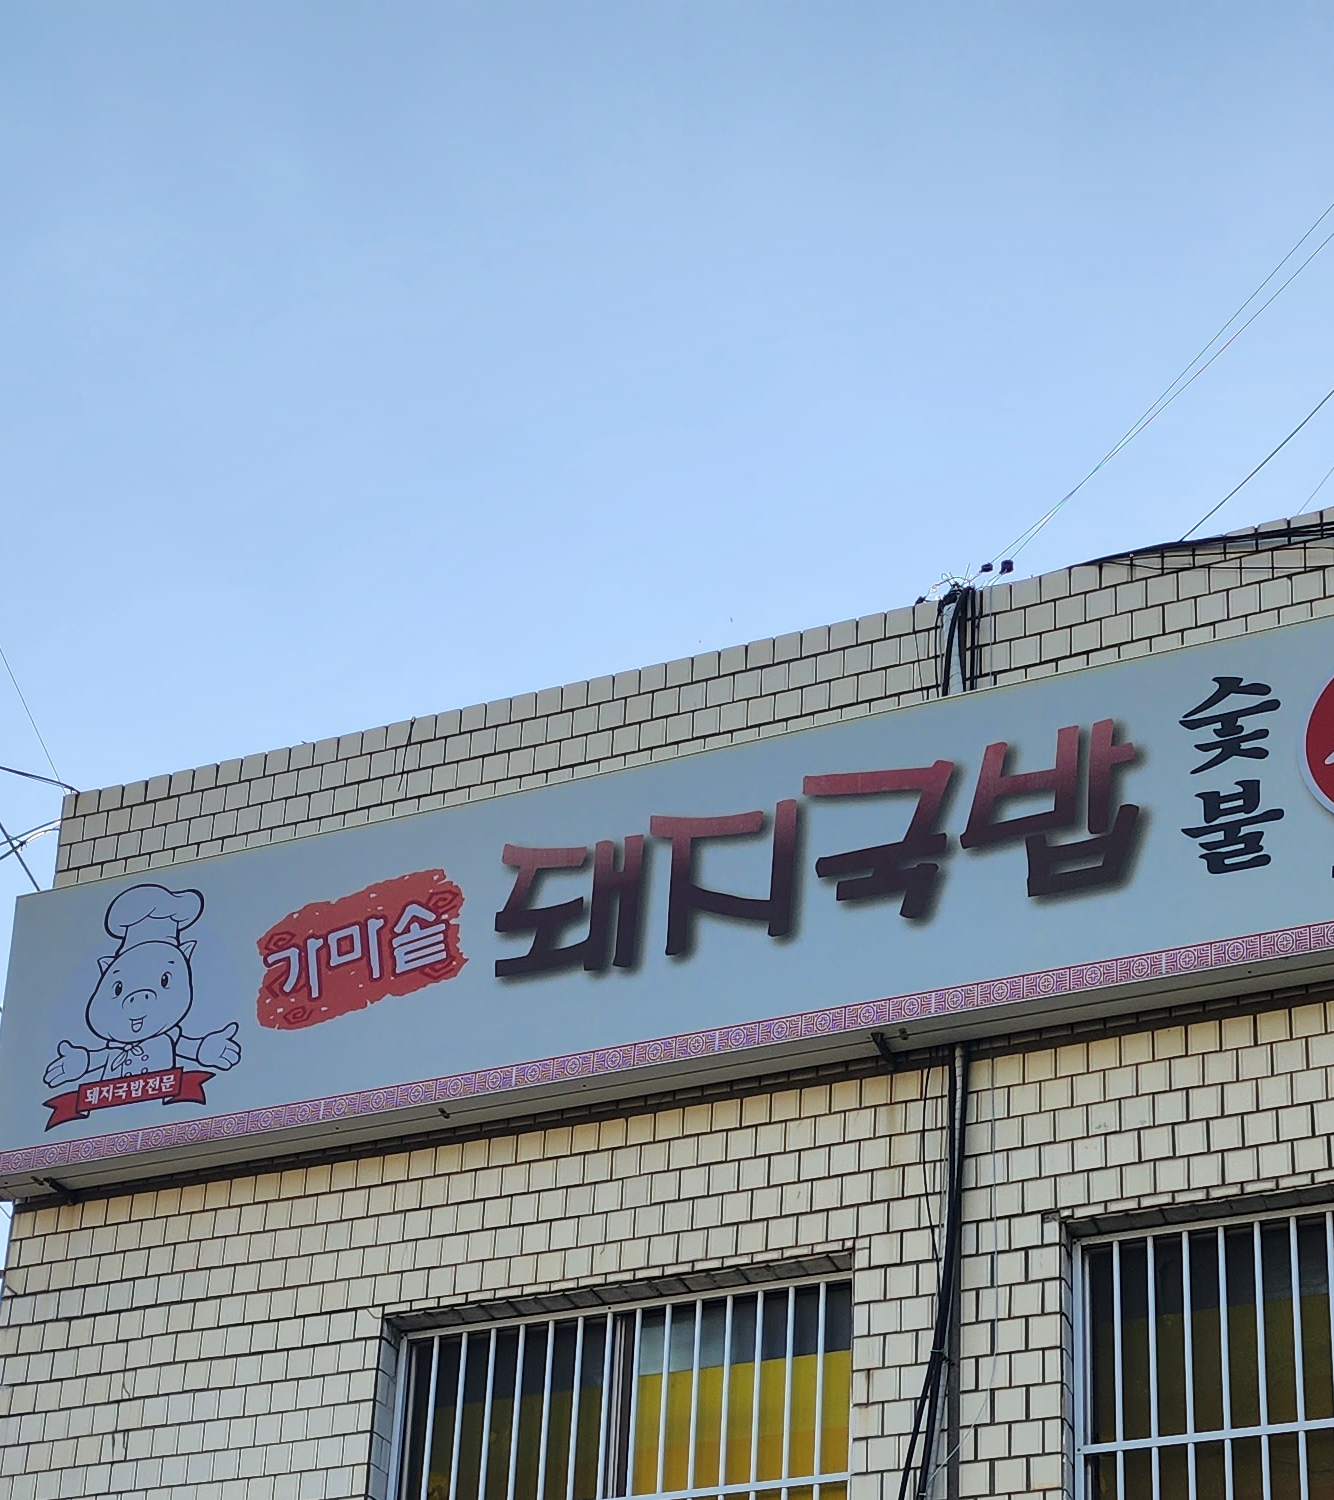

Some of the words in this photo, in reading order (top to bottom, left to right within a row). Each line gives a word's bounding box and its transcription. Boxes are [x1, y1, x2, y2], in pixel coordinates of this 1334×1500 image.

[494, 718, 1142, 978] 돼지국밥
[1178, 676, 1285, 875] 숯불
[264, 899, 450, 1000] 가마솥
[84, 1074, 177, 1106] 돼지국밥전문
